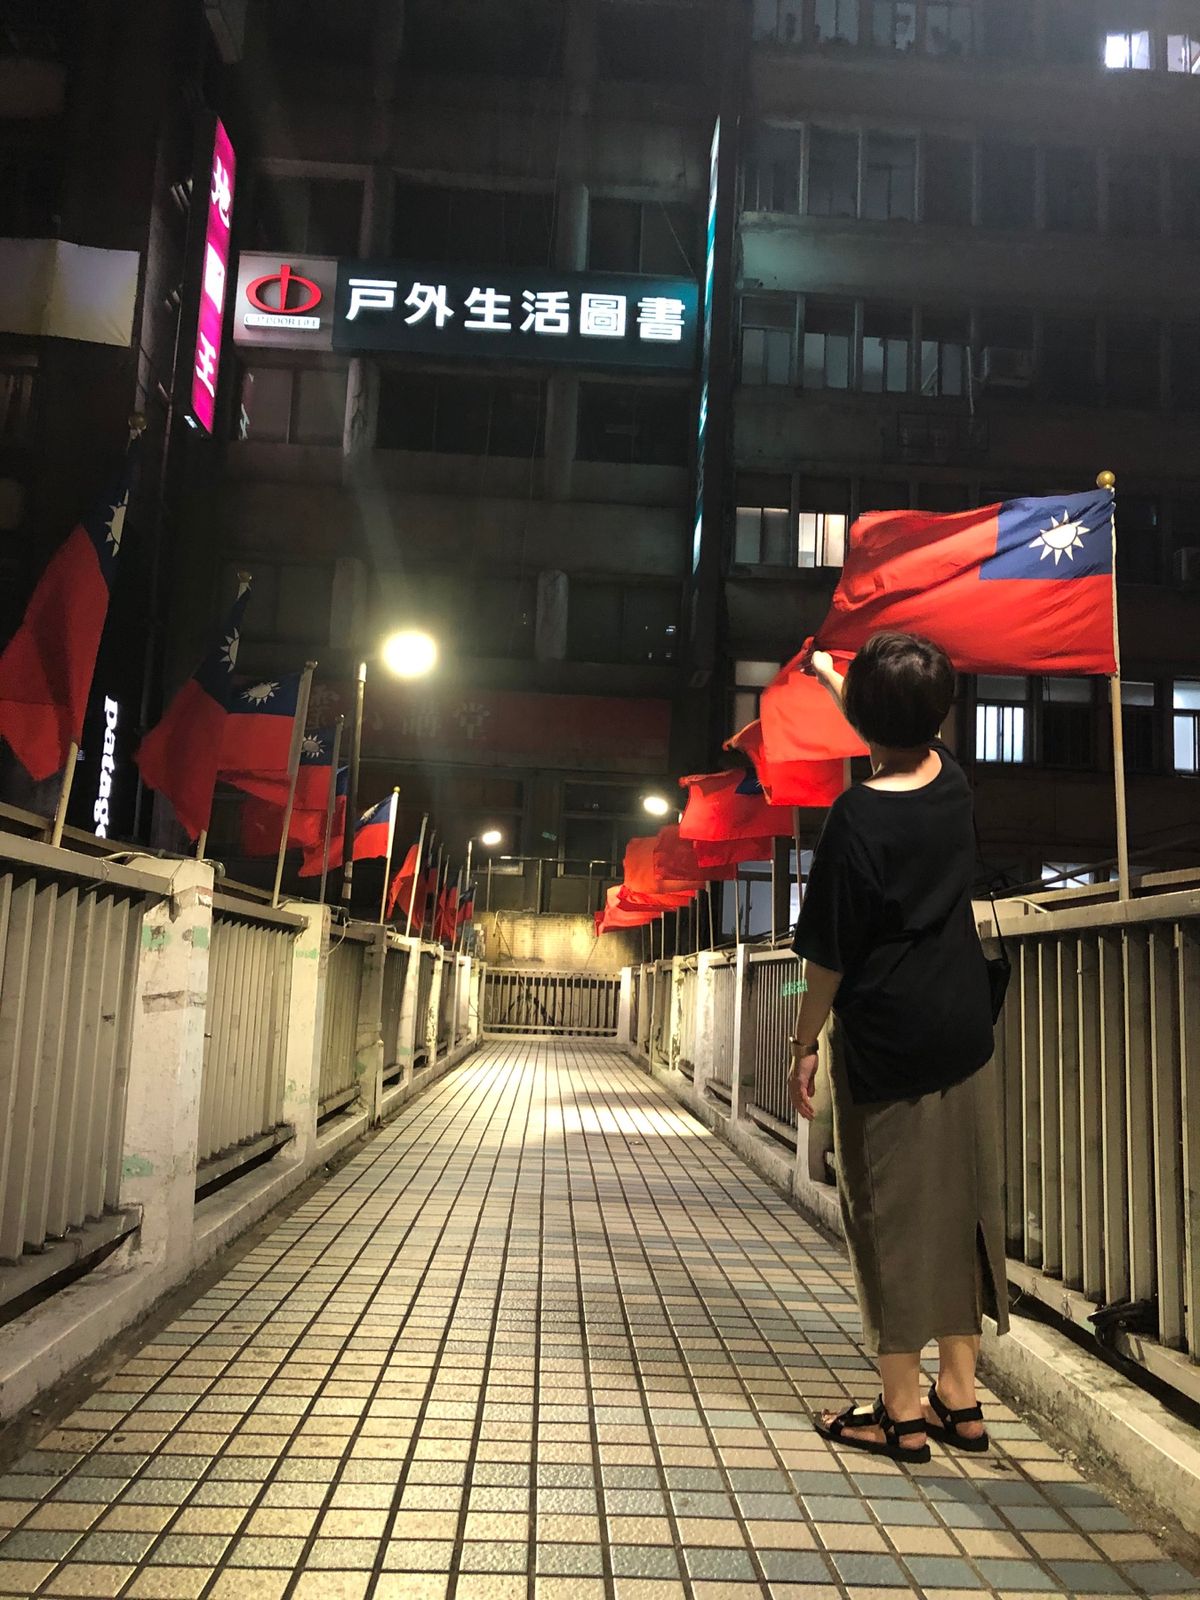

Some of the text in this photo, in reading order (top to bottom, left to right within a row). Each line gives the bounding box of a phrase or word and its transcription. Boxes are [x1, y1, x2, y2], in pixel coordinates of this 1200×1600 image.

[345, 278, 686, 342] 戶外生活圖書
